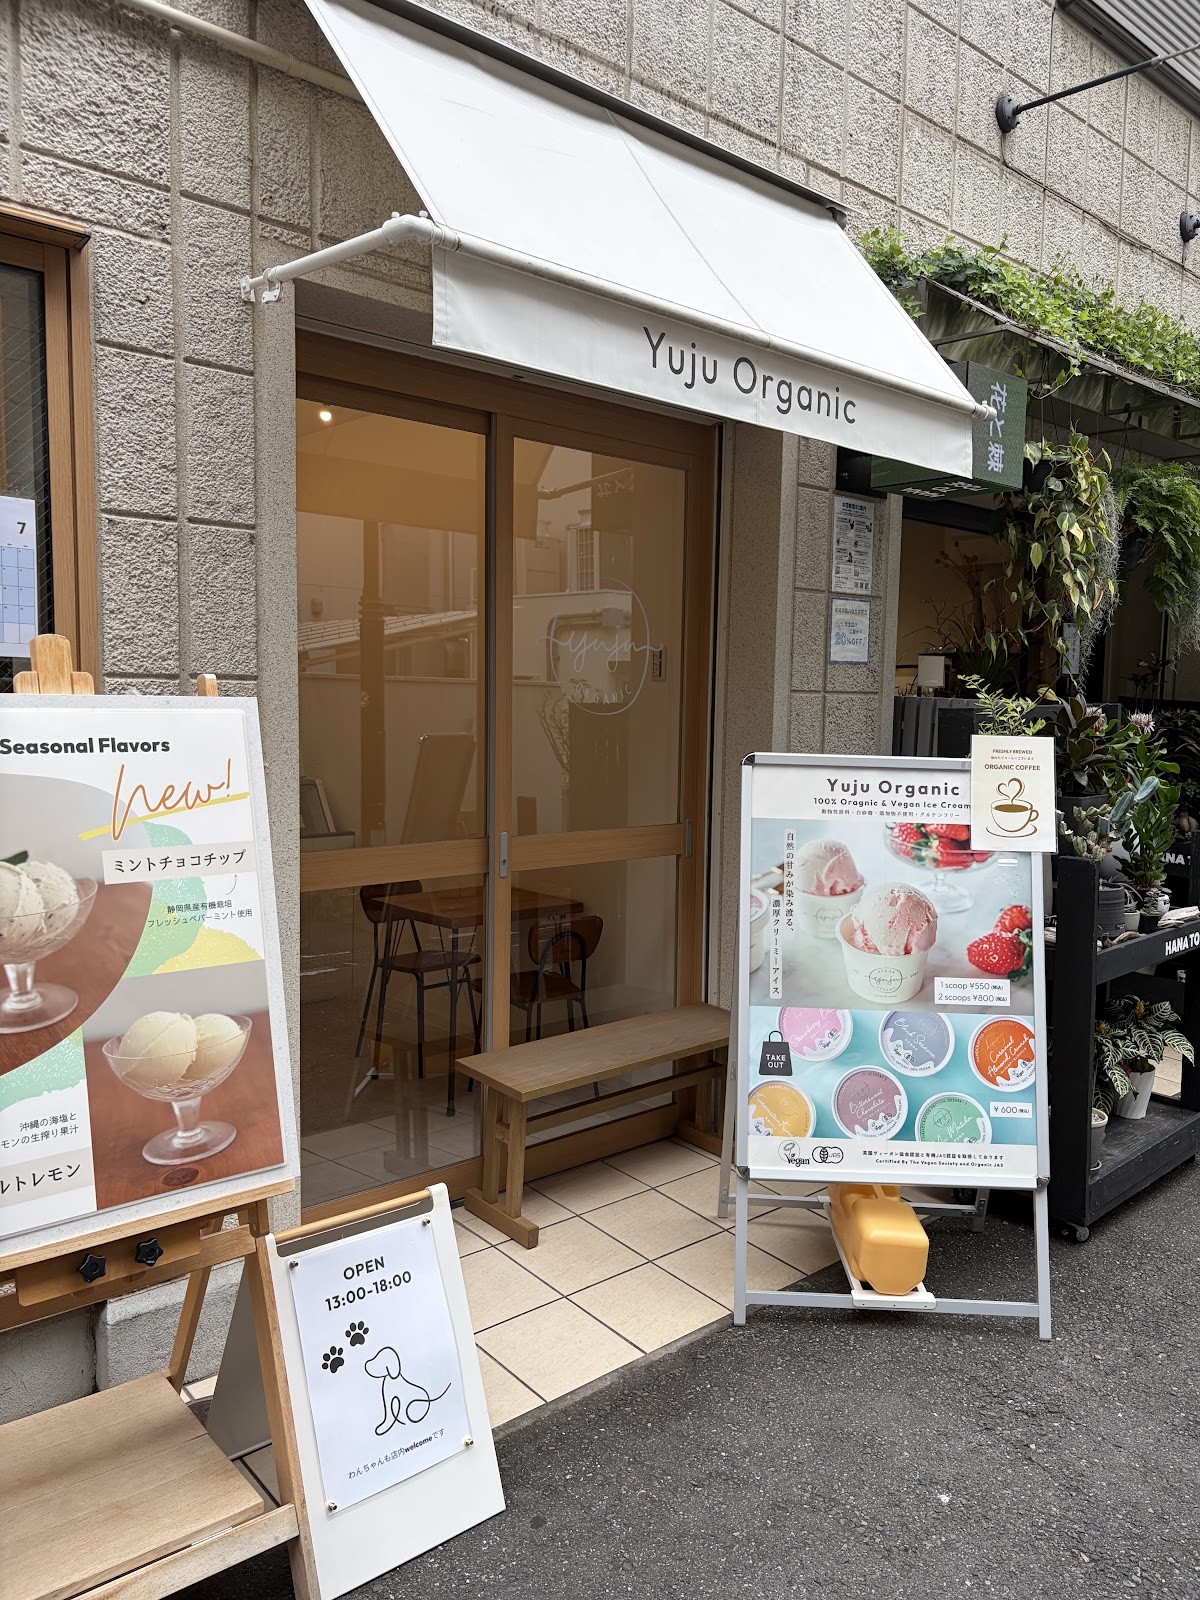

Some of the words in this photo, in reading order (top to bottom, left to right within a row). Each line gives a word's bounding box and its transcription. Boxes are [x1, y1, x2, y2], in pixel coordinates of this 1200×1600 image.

[642, 326, 718, 390] Yuju
[733, 356, 857, 424] Organic
[16, 521, 27, 534] 7
[0, 738, 93, 755] Seasonal
[98, 738, 171, 753] Flavors
[984, 763, 1015, 771] ORGANIC
[826, 778, 870, 797] Yuju
[878, 780, 961, 799] Organic
[813, 797, 838, 806] 100%
[840, 798, 879, 808] Oragnic
[890, 800, 921, 810] Vegan
[923, 801, 938, 809] Ice
[940, 801, 971, 810] Cream
[113, 848, 248, 874] ミントチョコチップ
[167, 900, 233, 914] 静岡県産有機栽培
[1165, 935, 1189, 956] HANA
[1189, 931, 1200, 948] TO
[945, 982, 968, 990] scoop
[969, 982, 990, 990] ¥550
[938, 993, 943, 1001] 2
[973, 994, 994, 1002] ¥800
[765, 1053, 787, 1062] TAKE
[767, 1061, 785, 1069] OUT
[1000, 1105, 1018, 1114] 600
[19, 1112, 77, 1132] 沖縄の海塩と
[0, 1124, 79, 1149] モンの生搾り果汁
[343, 1256, 386, 1281] OPEN
[324, 1270, 412, 1312] 13:00-18:00
[347, 1428, 445, 1480] わんちゃんも店内welcomeです
